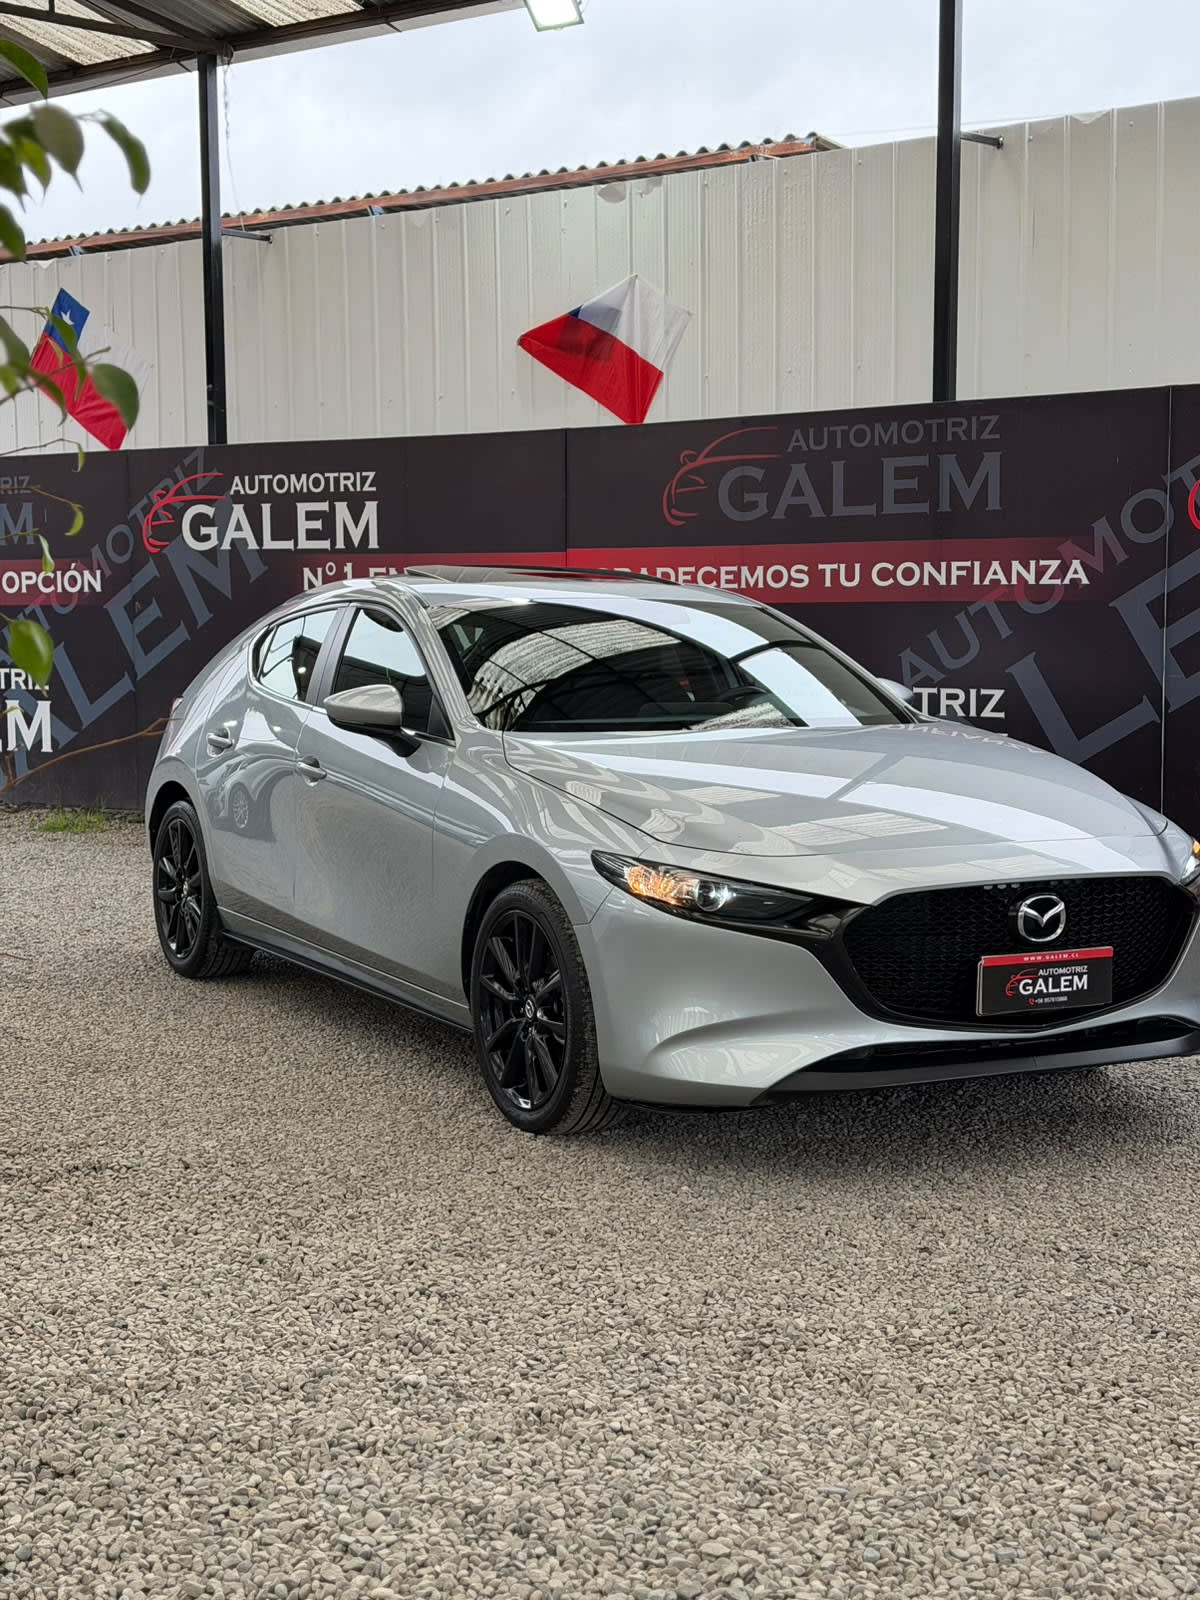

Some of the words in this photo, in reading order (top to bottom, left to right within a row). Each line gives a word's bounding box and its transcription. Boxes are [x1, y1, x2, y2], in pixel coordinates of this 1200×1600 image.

[787, 415, 1000, 452] AUTOMOTRIZ
[230, 472, 376, 495] AUTOMOTRIZ
[718, 452, 1003, 521] GALEM
[182, 501, 380, 552] GALEM
[1, 562, 102, 593] OPCIÓN
[818, 564, 861, 587] TU
[871, 560, 1090, 586] CONFIANZA
[1018, 974, 1088, 995] GALEM
[1037, 965, 1088, 976] AUTOMOTRIZ
